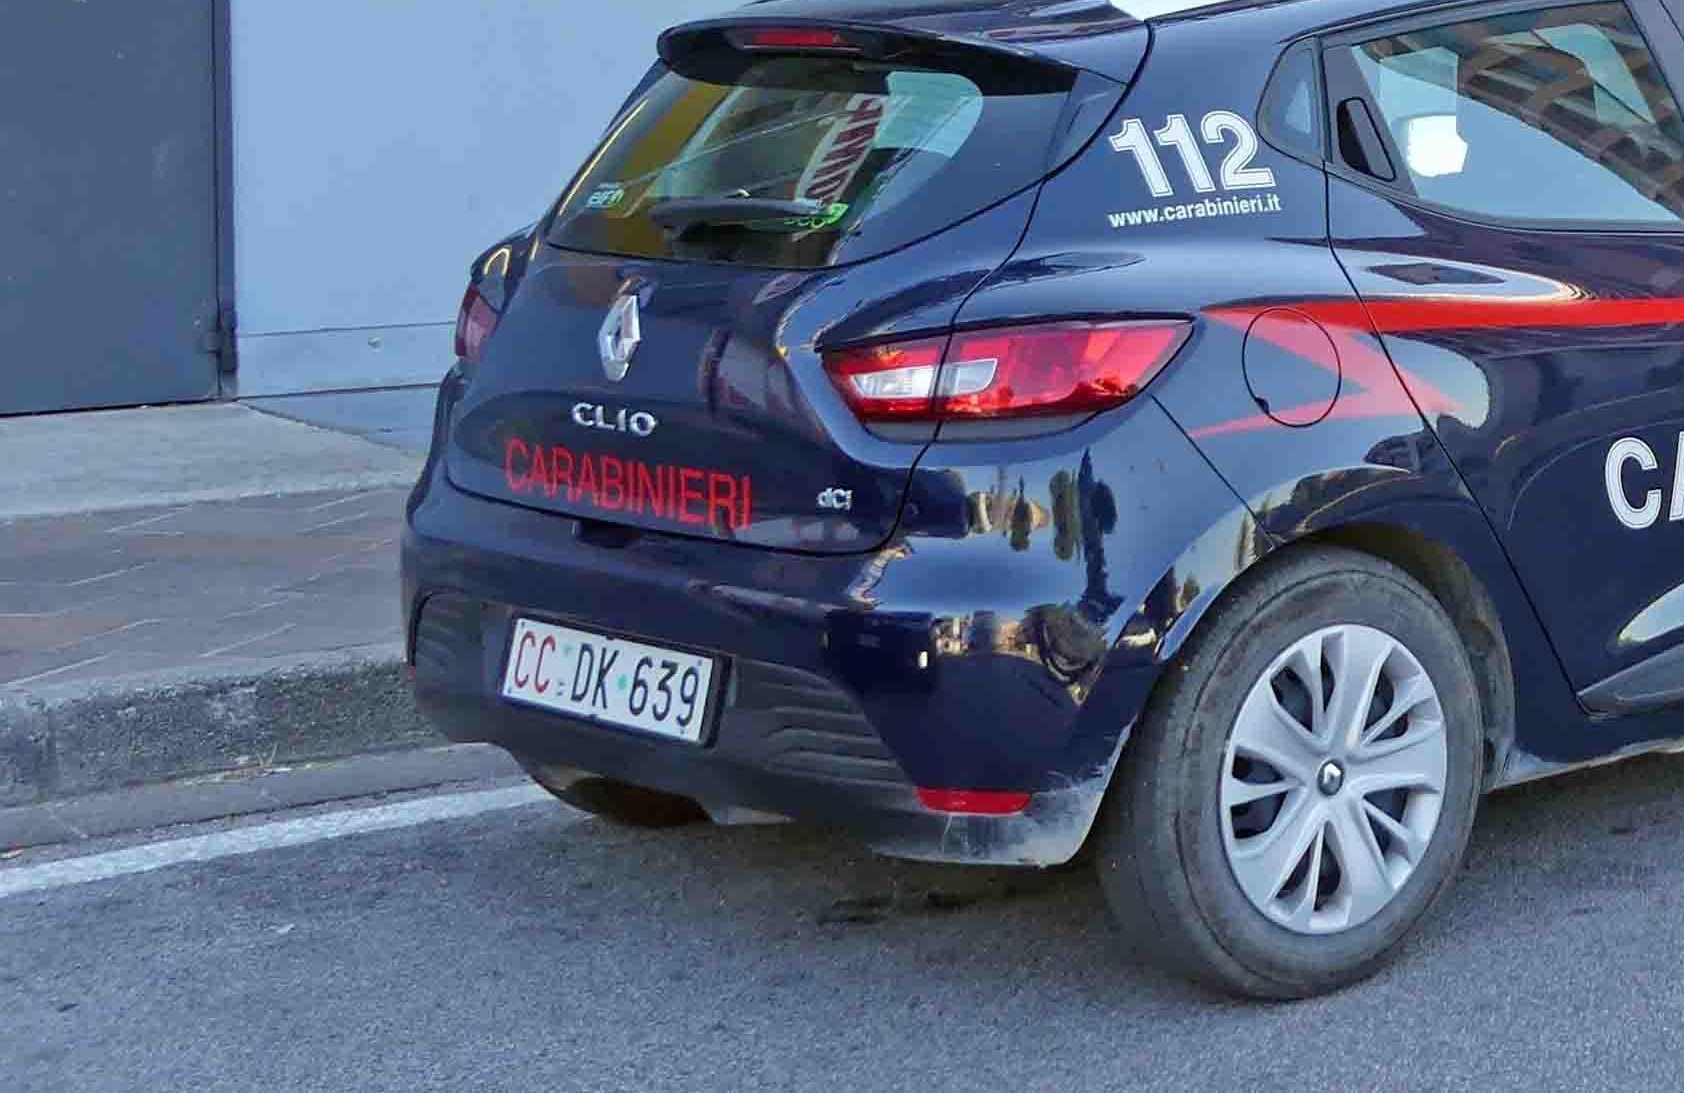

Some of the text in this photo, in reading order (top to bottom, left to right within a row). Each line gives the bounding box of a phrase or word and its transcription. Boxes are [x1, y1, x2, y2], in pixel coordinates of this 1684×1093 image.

[1108, 110, 1277, 198] 112
[1108, 193, 1282, 229] www.carabinieri.it
[571, 402, 657, 437] CLIO
[504, 436, 753, 534] CARABINIERI
[817, 487, 852, 510] dCi
[514, 630, 700, 727] CC DK 639
